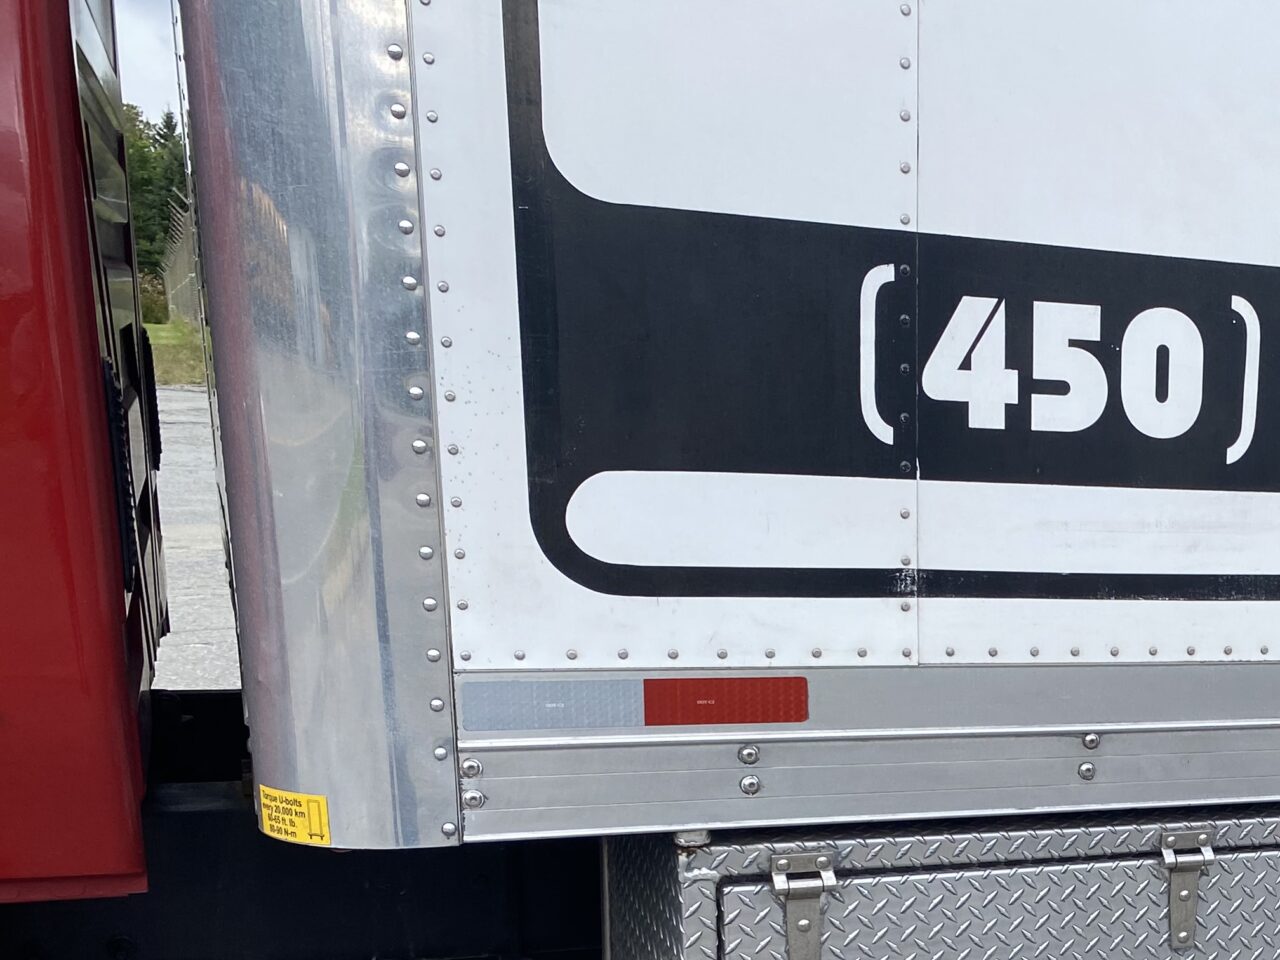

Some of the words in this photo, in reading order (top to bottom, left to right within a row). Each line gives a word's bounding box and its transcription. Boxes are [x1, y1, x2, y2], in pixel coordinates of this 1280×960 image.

[859, 263, 1261, 464] (450)
[262, 790, 278, 803] Torque
[279, 796, 302, 808] U-bolts
[274, 804, 293, 817] 20,000
[294, 808, 306, 819] km
